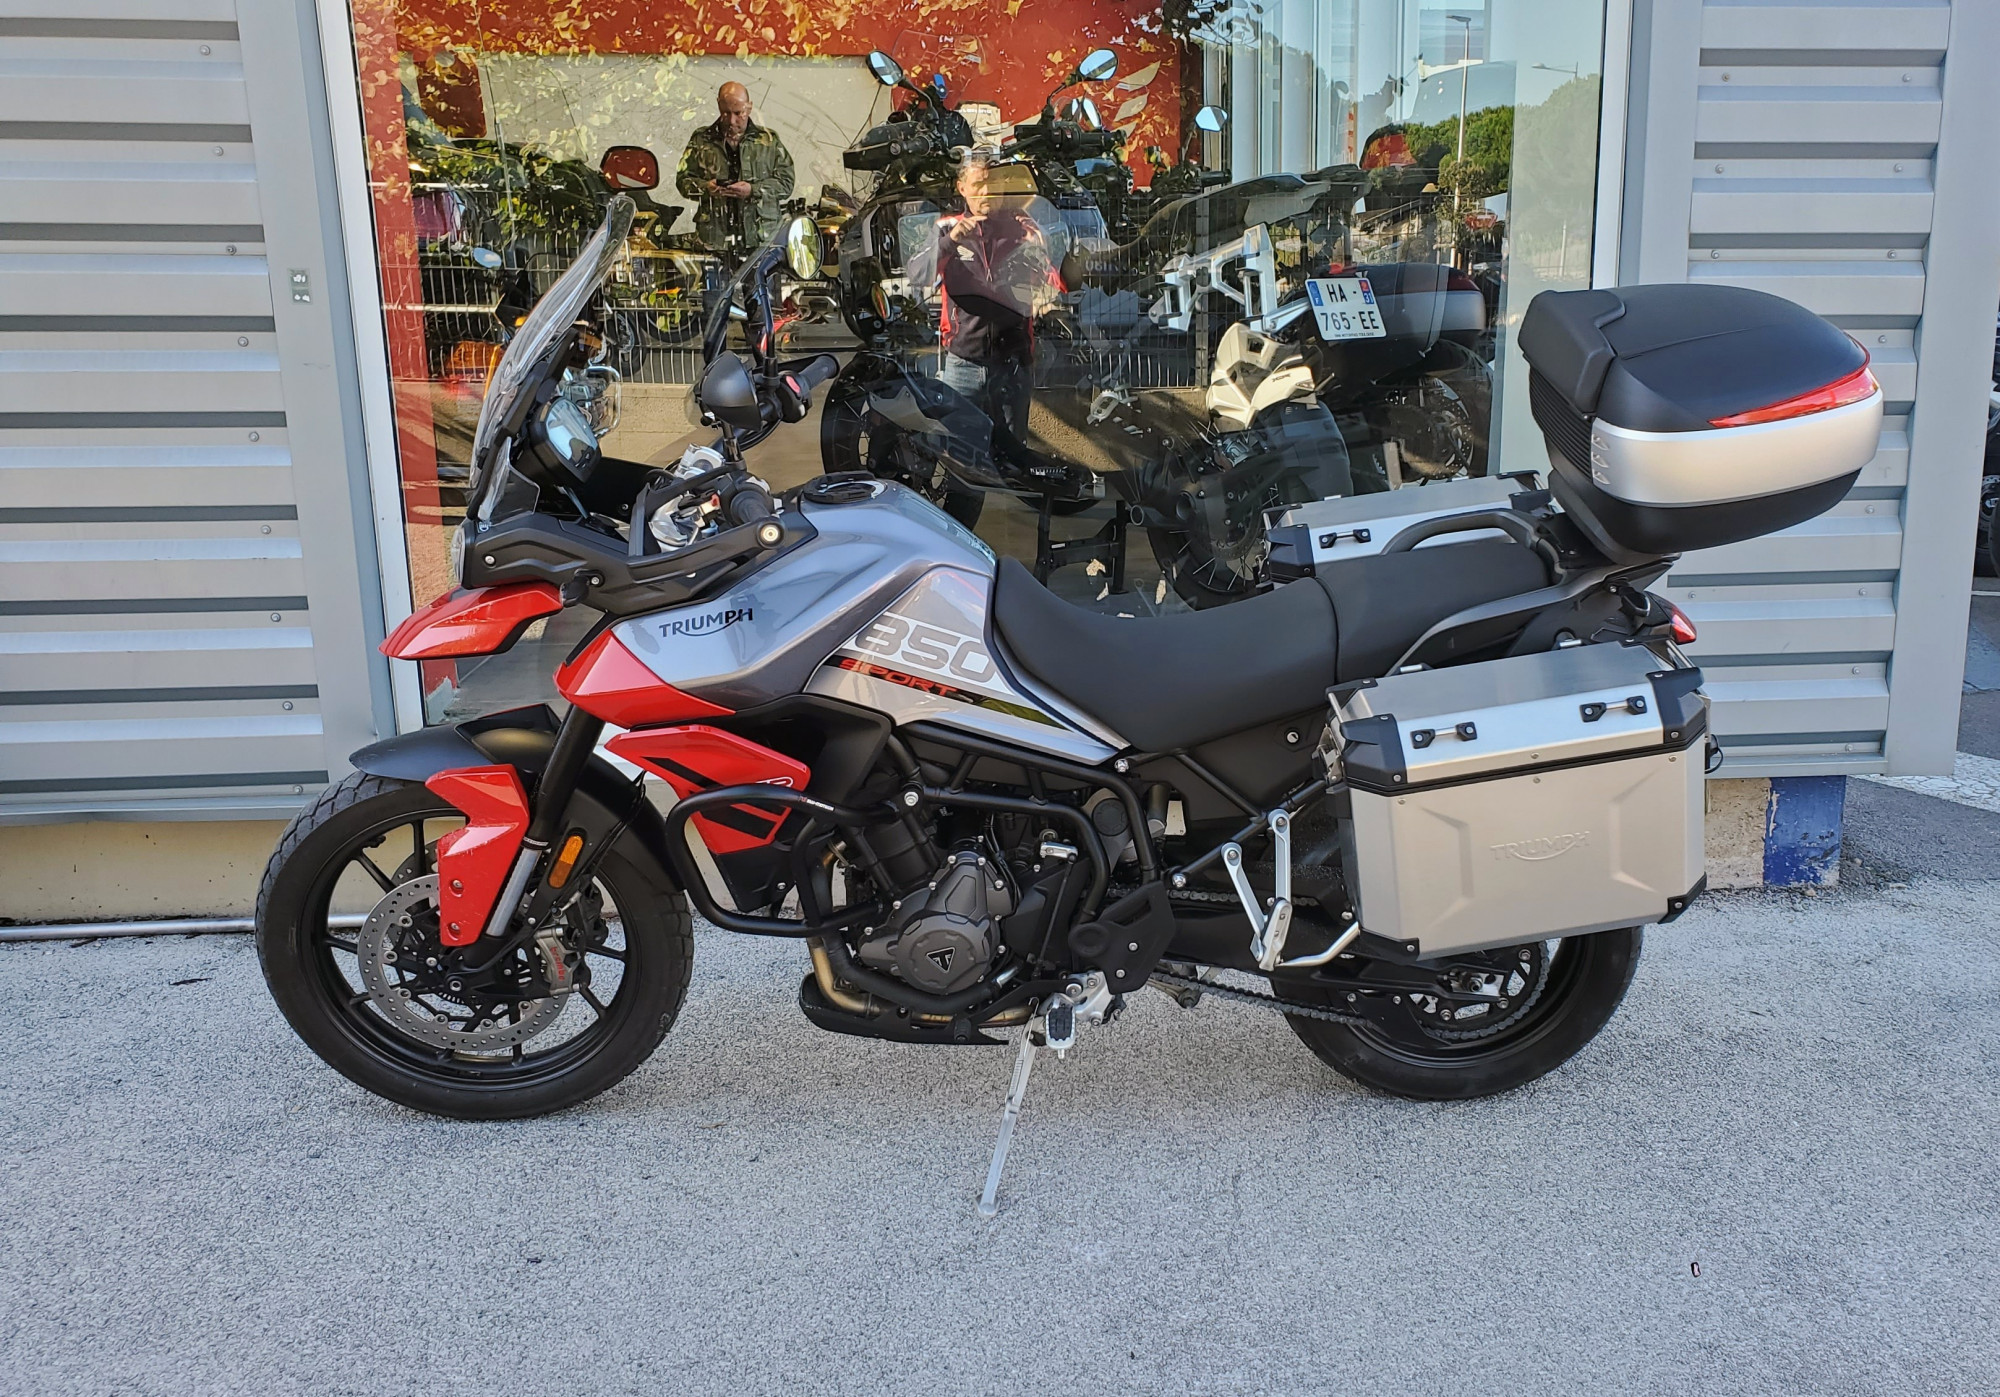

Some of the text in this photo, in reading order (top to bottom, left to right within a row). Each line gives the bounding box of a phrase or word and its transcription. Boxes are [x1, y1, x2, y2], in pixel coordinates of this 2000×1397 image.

[1364, 293, 1375, 305] 31
[1320, 310, 1380, 332] 765-EE
[658, 608, 753, 638] TRIUMPH
[839, 659, 958, 697] SPORT
[1489, 830, 1591, 862] TRIUMPH
